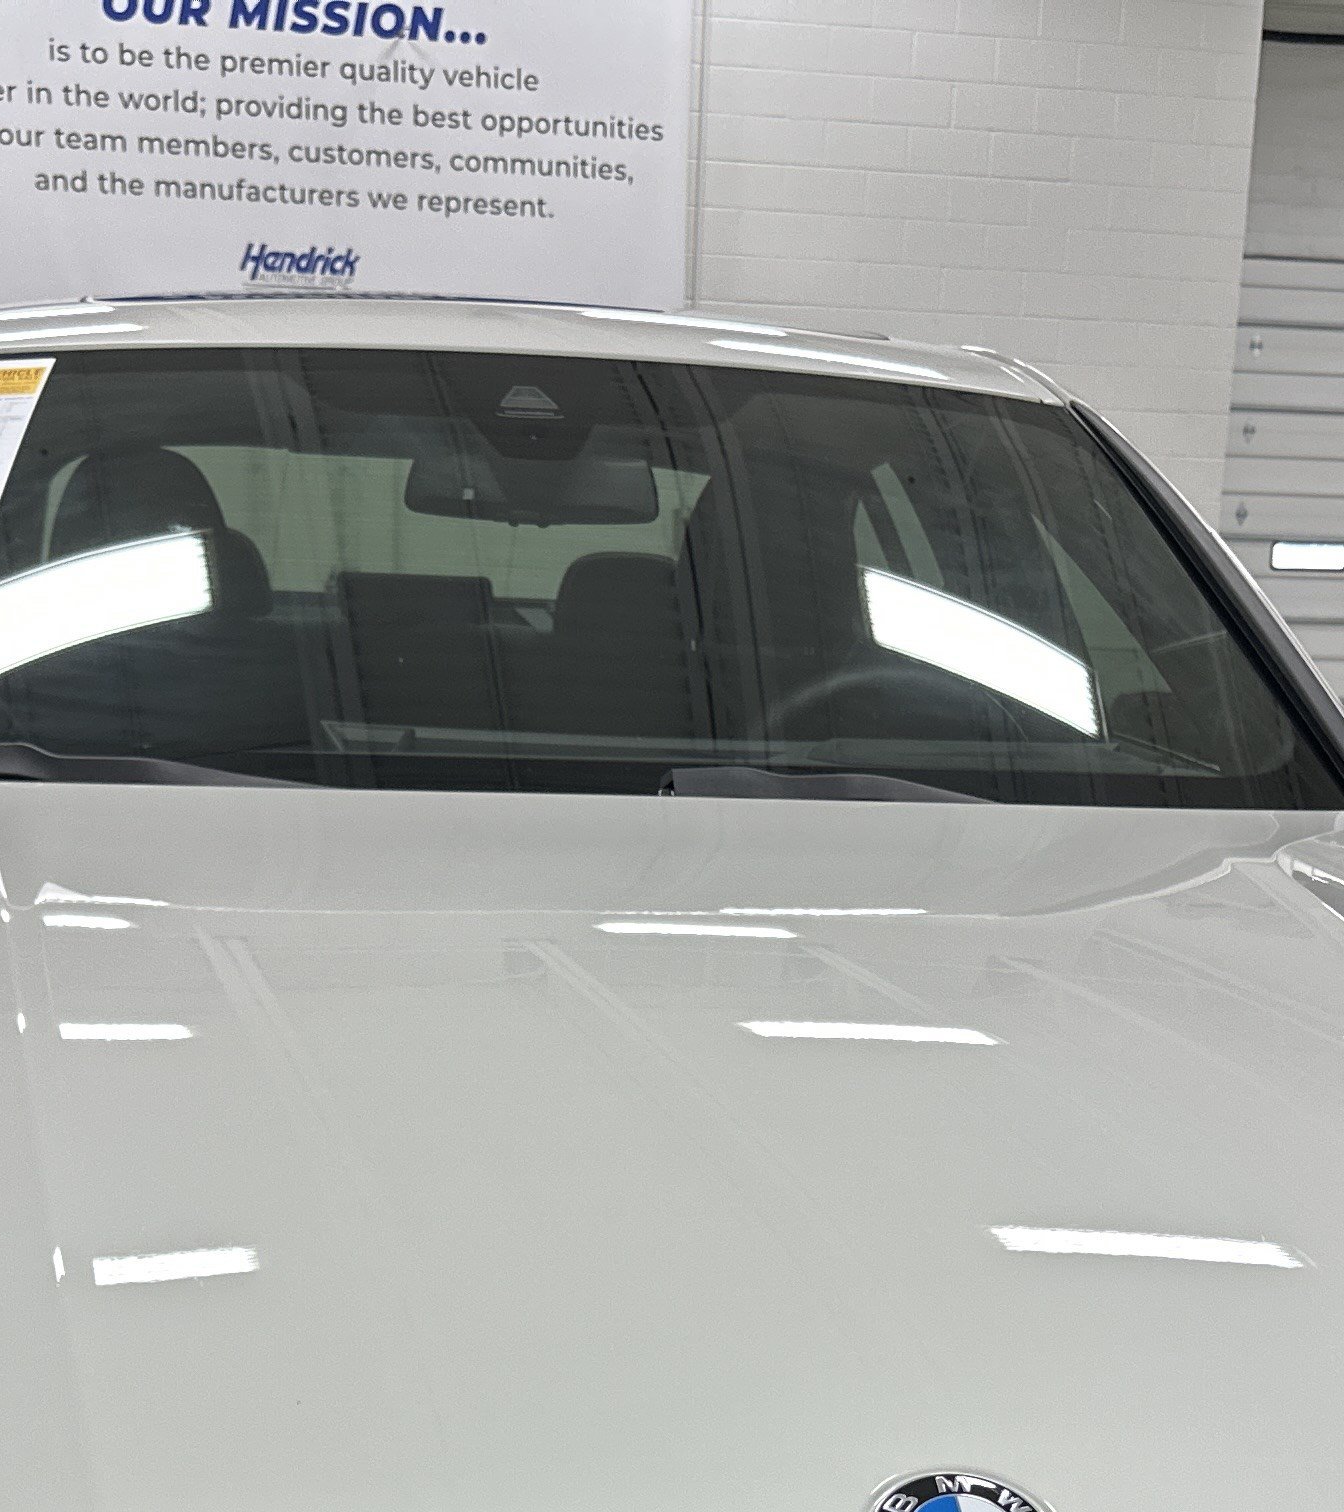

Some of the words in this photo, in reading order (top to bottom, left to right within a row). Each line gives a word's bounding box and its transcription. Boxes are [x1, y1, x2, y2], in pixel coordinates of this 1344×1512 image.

[101, 0, 208, 27] OUR
[228, 0, 487, 45] MISSION...
[48, 37, 71, 63] is
[79, 41, 109, 66] to
[118, 43, 155, 68] be
[163, 46, 210, 72] the
[220, 53, 330, 79] premier
[339, 59, 436, 91] quality
[442, 66, 540, 92] vehicle
[26, 80, 53, 105] in
[62, 83, 110, 109] the
[118, 89, 207, 118] world;
[216, 95, 348, 128] providing
[357, 101, 403, 127] the
[412, 105, 473, 131] best
[481, 112, 665, 142] opportunities
[54, 127, 127, 154] team
[137, 135, 280, 166] members,
[288, 144, 442, 174] customers,
[449, 153, 635, 185] communities,
[34, 170, 88, 194] and
[98, 172, 145, 197] the
[154, 178, 359, 208] manufacturers
[367, 190, 408, 211] we
[417, 192, 555, 219] represent.
[240, 243, 361, 280] Hendrick
